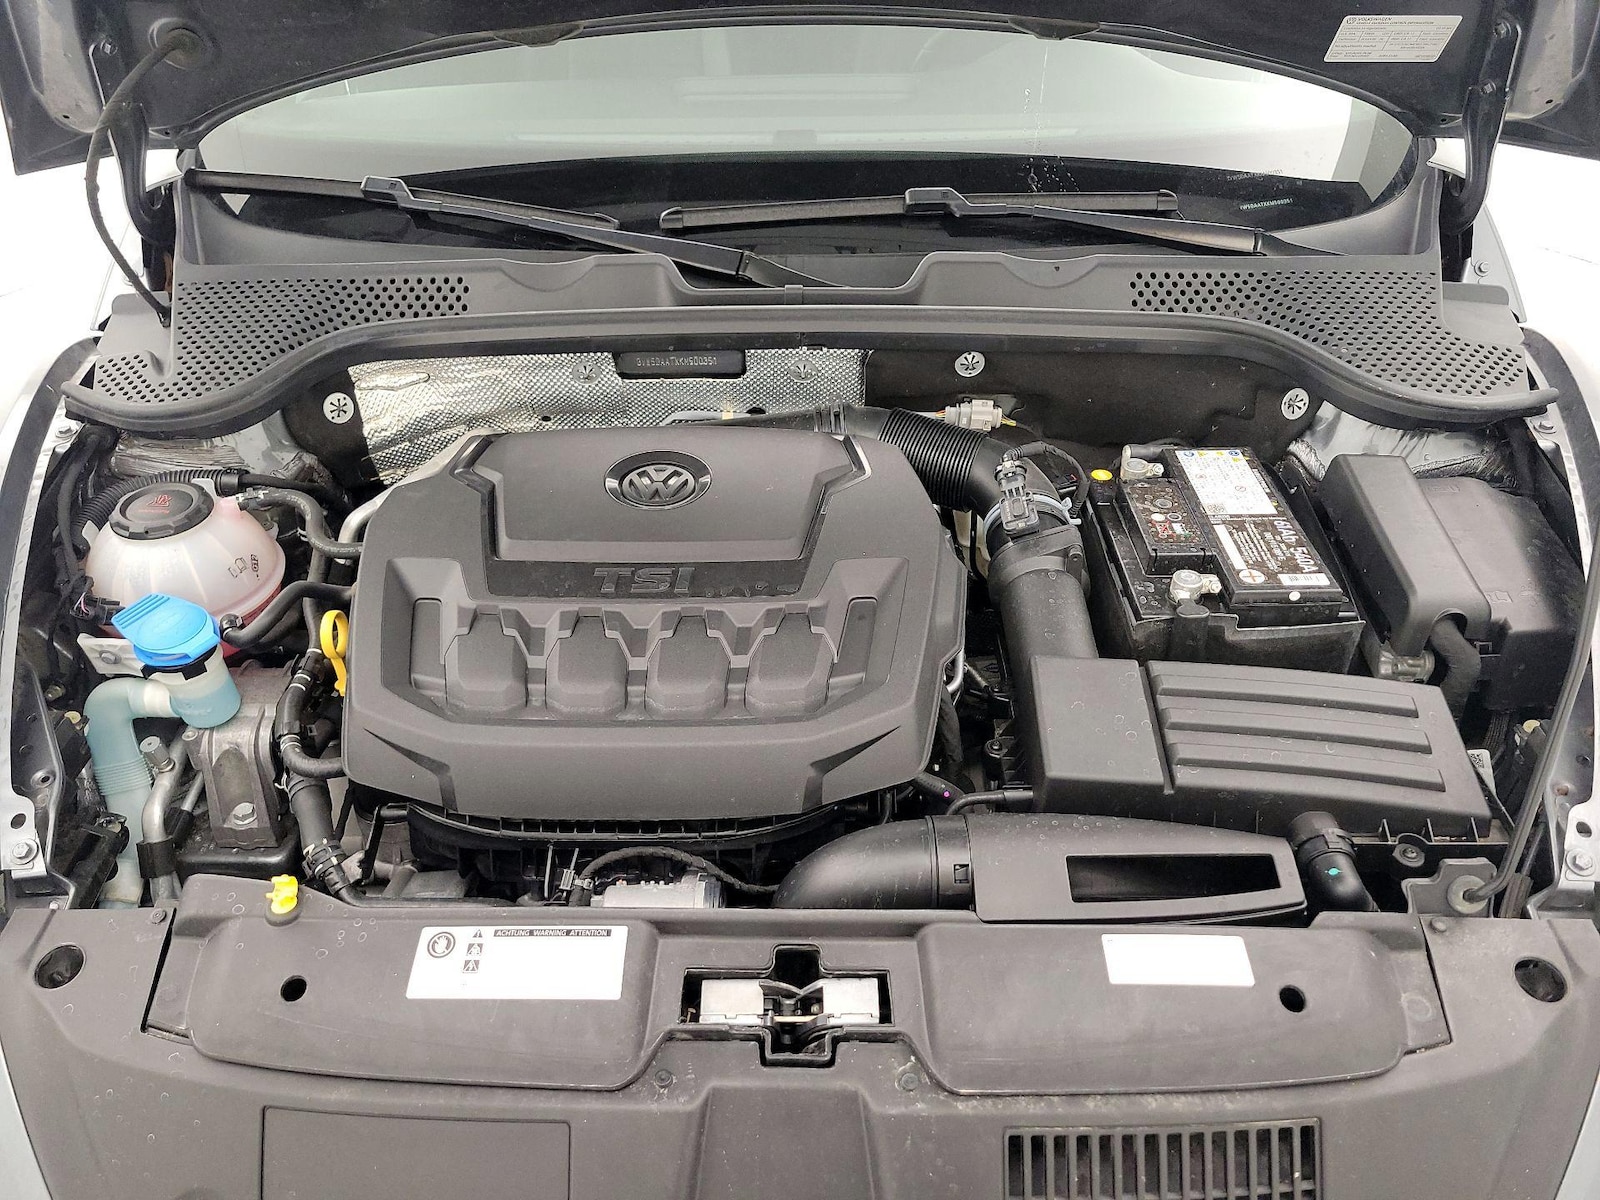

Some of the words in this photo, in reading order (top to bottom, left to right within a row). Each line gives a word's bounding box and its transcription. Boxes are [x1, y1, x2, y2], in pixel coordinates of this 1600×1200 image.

[593, 567, 696, 594] TSI
[495, 929, 530, 937] ACHTUNG
[533, 929, 567, 937] WARNING
[569, 929, 608, 937] ATTENTION
